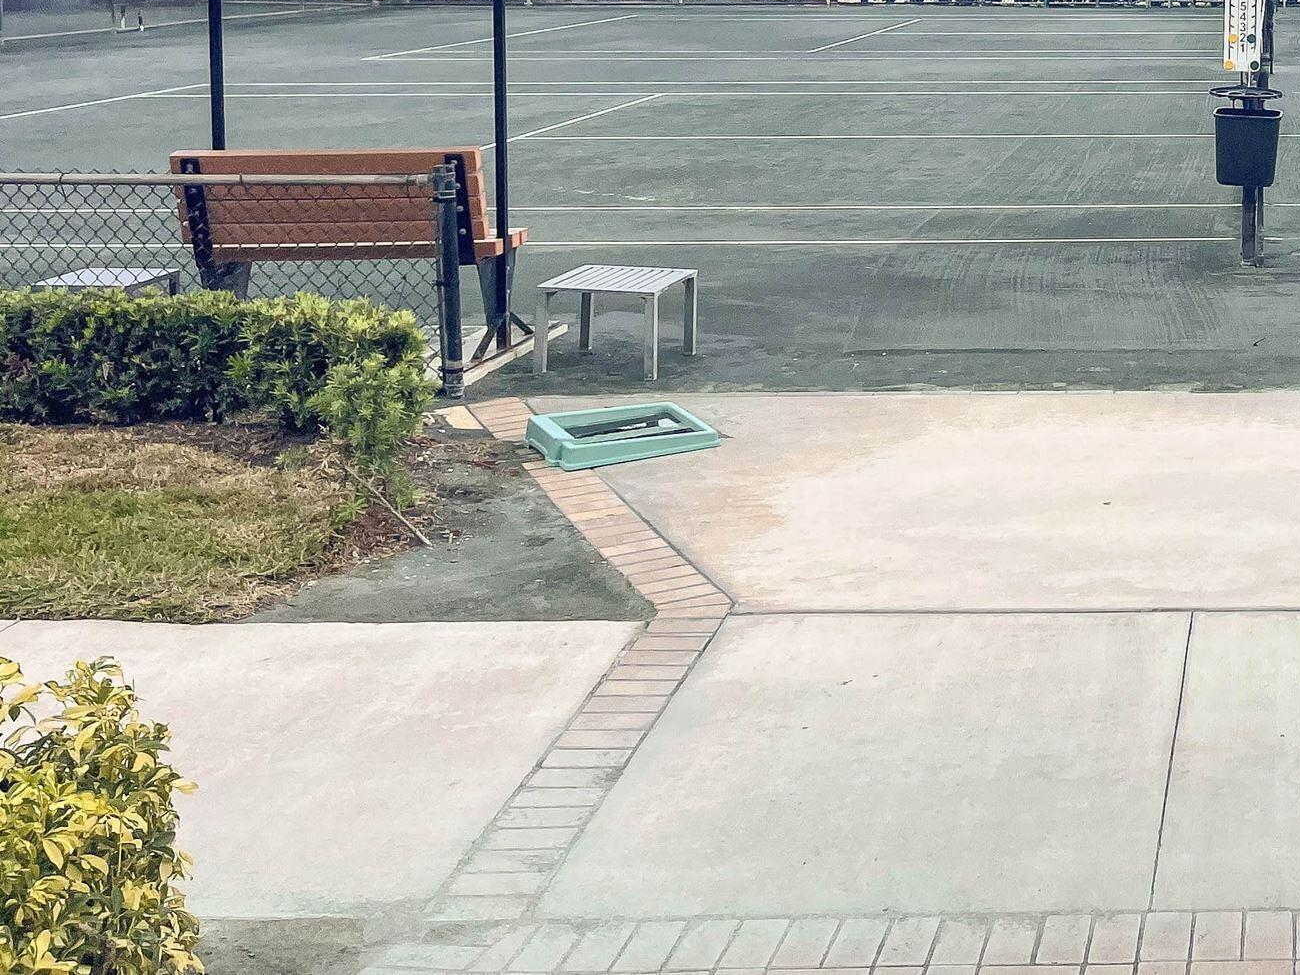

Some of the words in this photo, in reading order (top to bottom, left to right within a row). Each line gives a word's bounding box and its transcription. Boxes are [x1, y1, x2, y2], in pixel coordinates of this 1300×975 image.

[1240, 1, 1247, 11] 5
[1240, 12, 1246, 21] 4
[1240, 22, 1247, 32] 3
[1240, 33, 1247, 43] 2
[1240, 44, 1245, 53] 1
